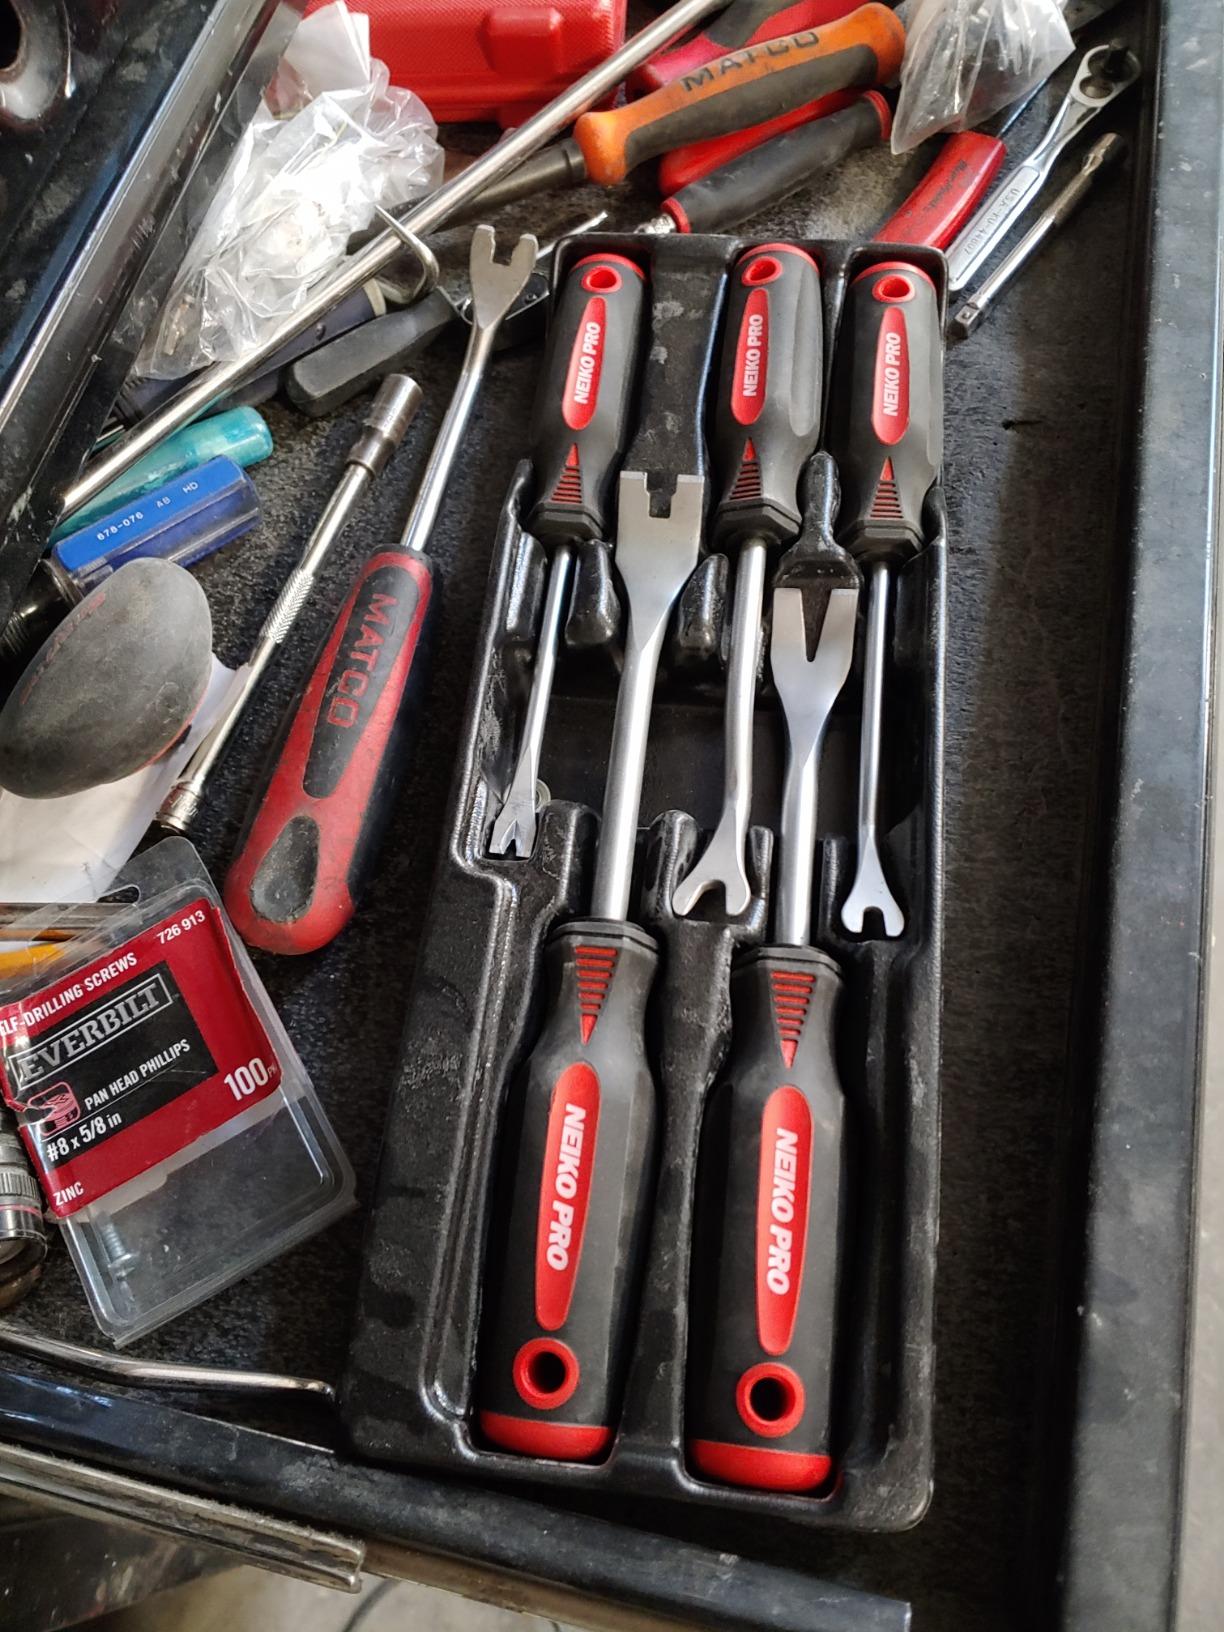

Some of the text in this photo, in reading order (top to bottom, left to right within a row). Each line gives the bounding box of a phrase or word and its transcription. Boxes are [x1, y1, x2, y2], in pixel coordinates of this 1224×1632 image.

[680, 31, 819, 91] MATCO
[574, 321, 601, 405] NEIKO PRO
[742, 313, 763, 397] NEIKO PRO
[883, 331, 902, 417] NEIKO PRO
[327, 592, 397, 729] MATCO
[156, 910, 206, 945] 726 913
[0, 952, 138, 1037] ELF-DRILLING SCREWS
[18, 982, 160, 1081] EVERBILT
[84, 1038, 191, 1111] PAN HEAD PHILLIPS
[223, 1057, 269, 1101] 100
[47, 1111, 123, 1162] #8 x 5/8 in
[52, 1181, 85, 1206] ZINC
[546, 1103, 587, 1271] NEIKO PRO
[766, 1127, 798, 1296] NEIKO PRO
